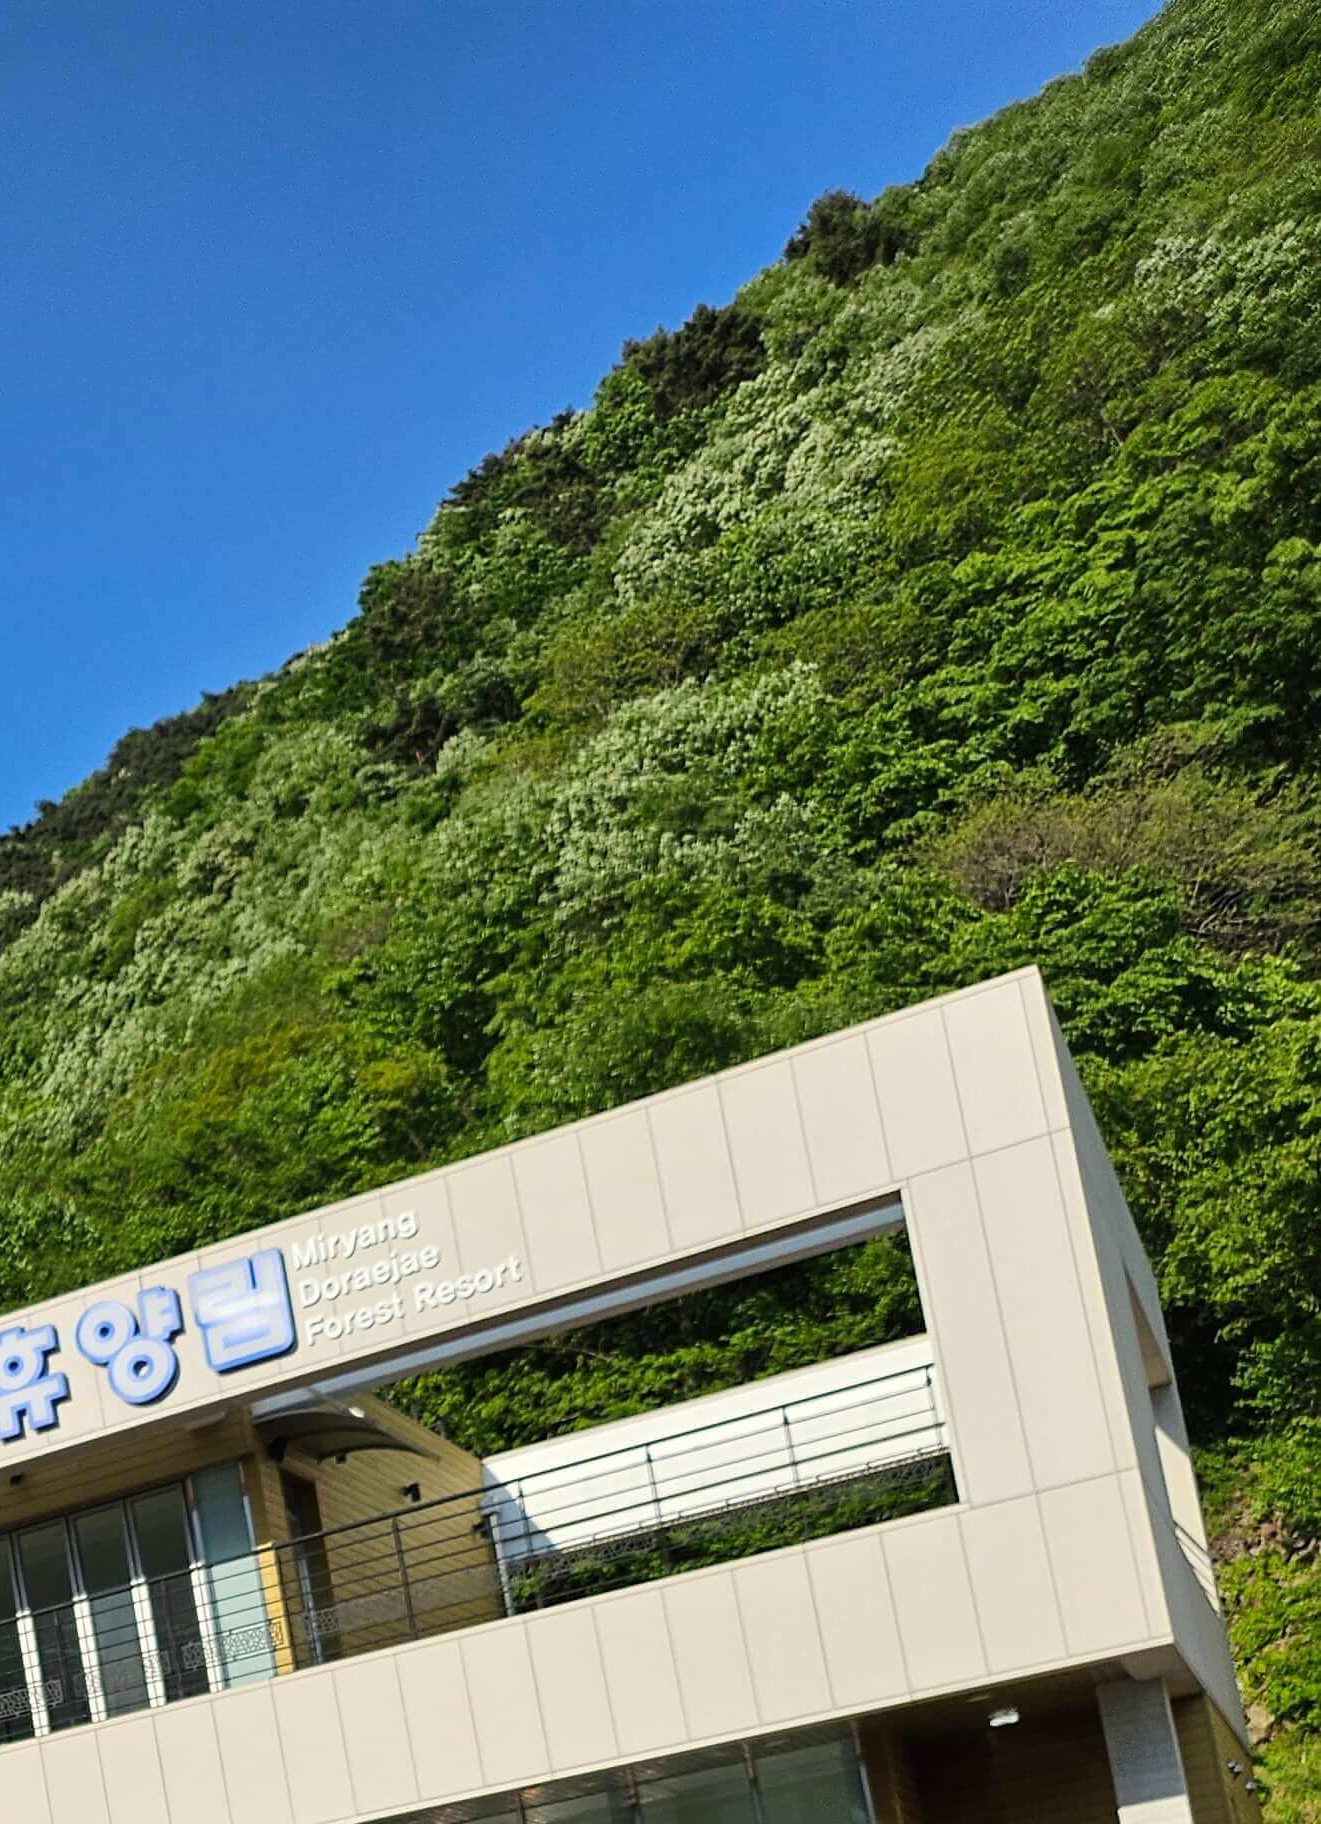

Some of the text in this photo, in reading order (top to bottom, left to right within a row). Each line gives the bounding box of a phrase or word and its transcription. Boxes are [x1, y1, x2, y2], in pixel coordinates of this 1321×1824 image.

[292, 1209, 419, 1270] Miryang
[300, 1246, 441, 1308] Doraejae
[306, 1252, 524, 1346] Forest Resort
